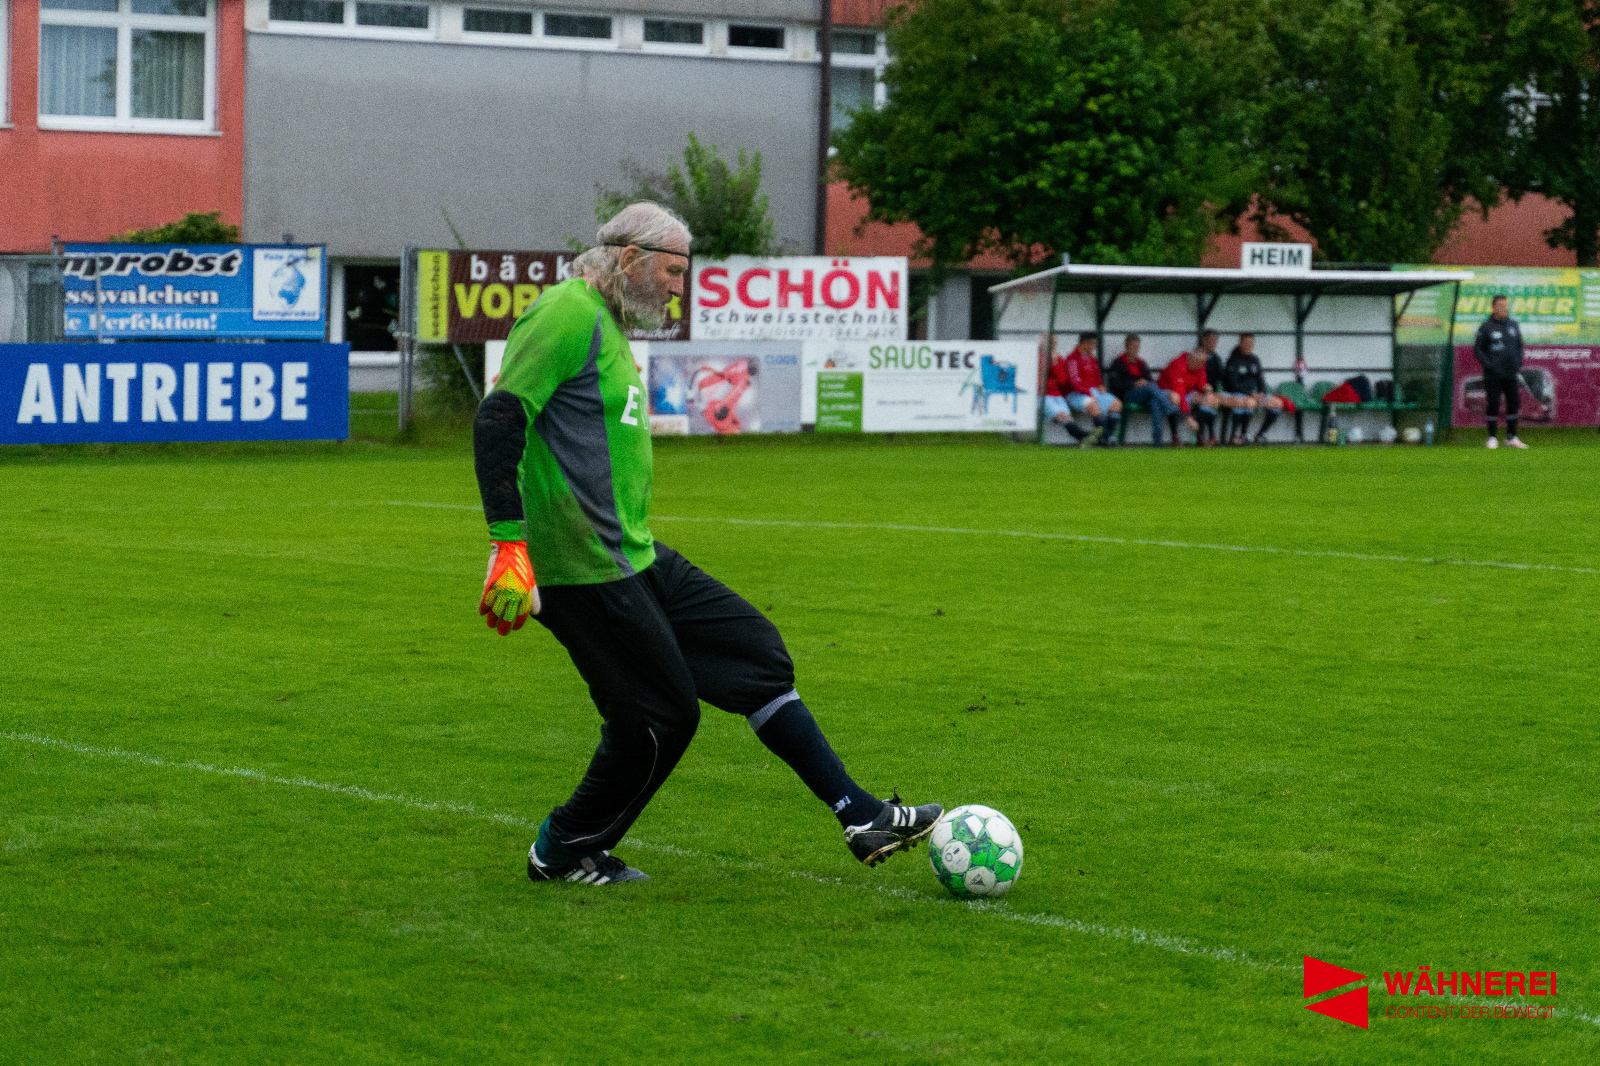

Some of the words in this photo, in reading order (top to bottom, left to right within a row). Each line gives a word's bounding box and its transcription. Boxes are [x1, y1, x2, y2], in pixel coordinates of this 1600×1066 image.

[1250, 247, 1303, 266] HEIM
[698, 260, 899, 309] SCHÖN
[700, 309, 898, 324] Schweisstechnik
[869, 345, 974, 369] SAUGTEC
[16, 362, 309, 424] ANTRIEBE
